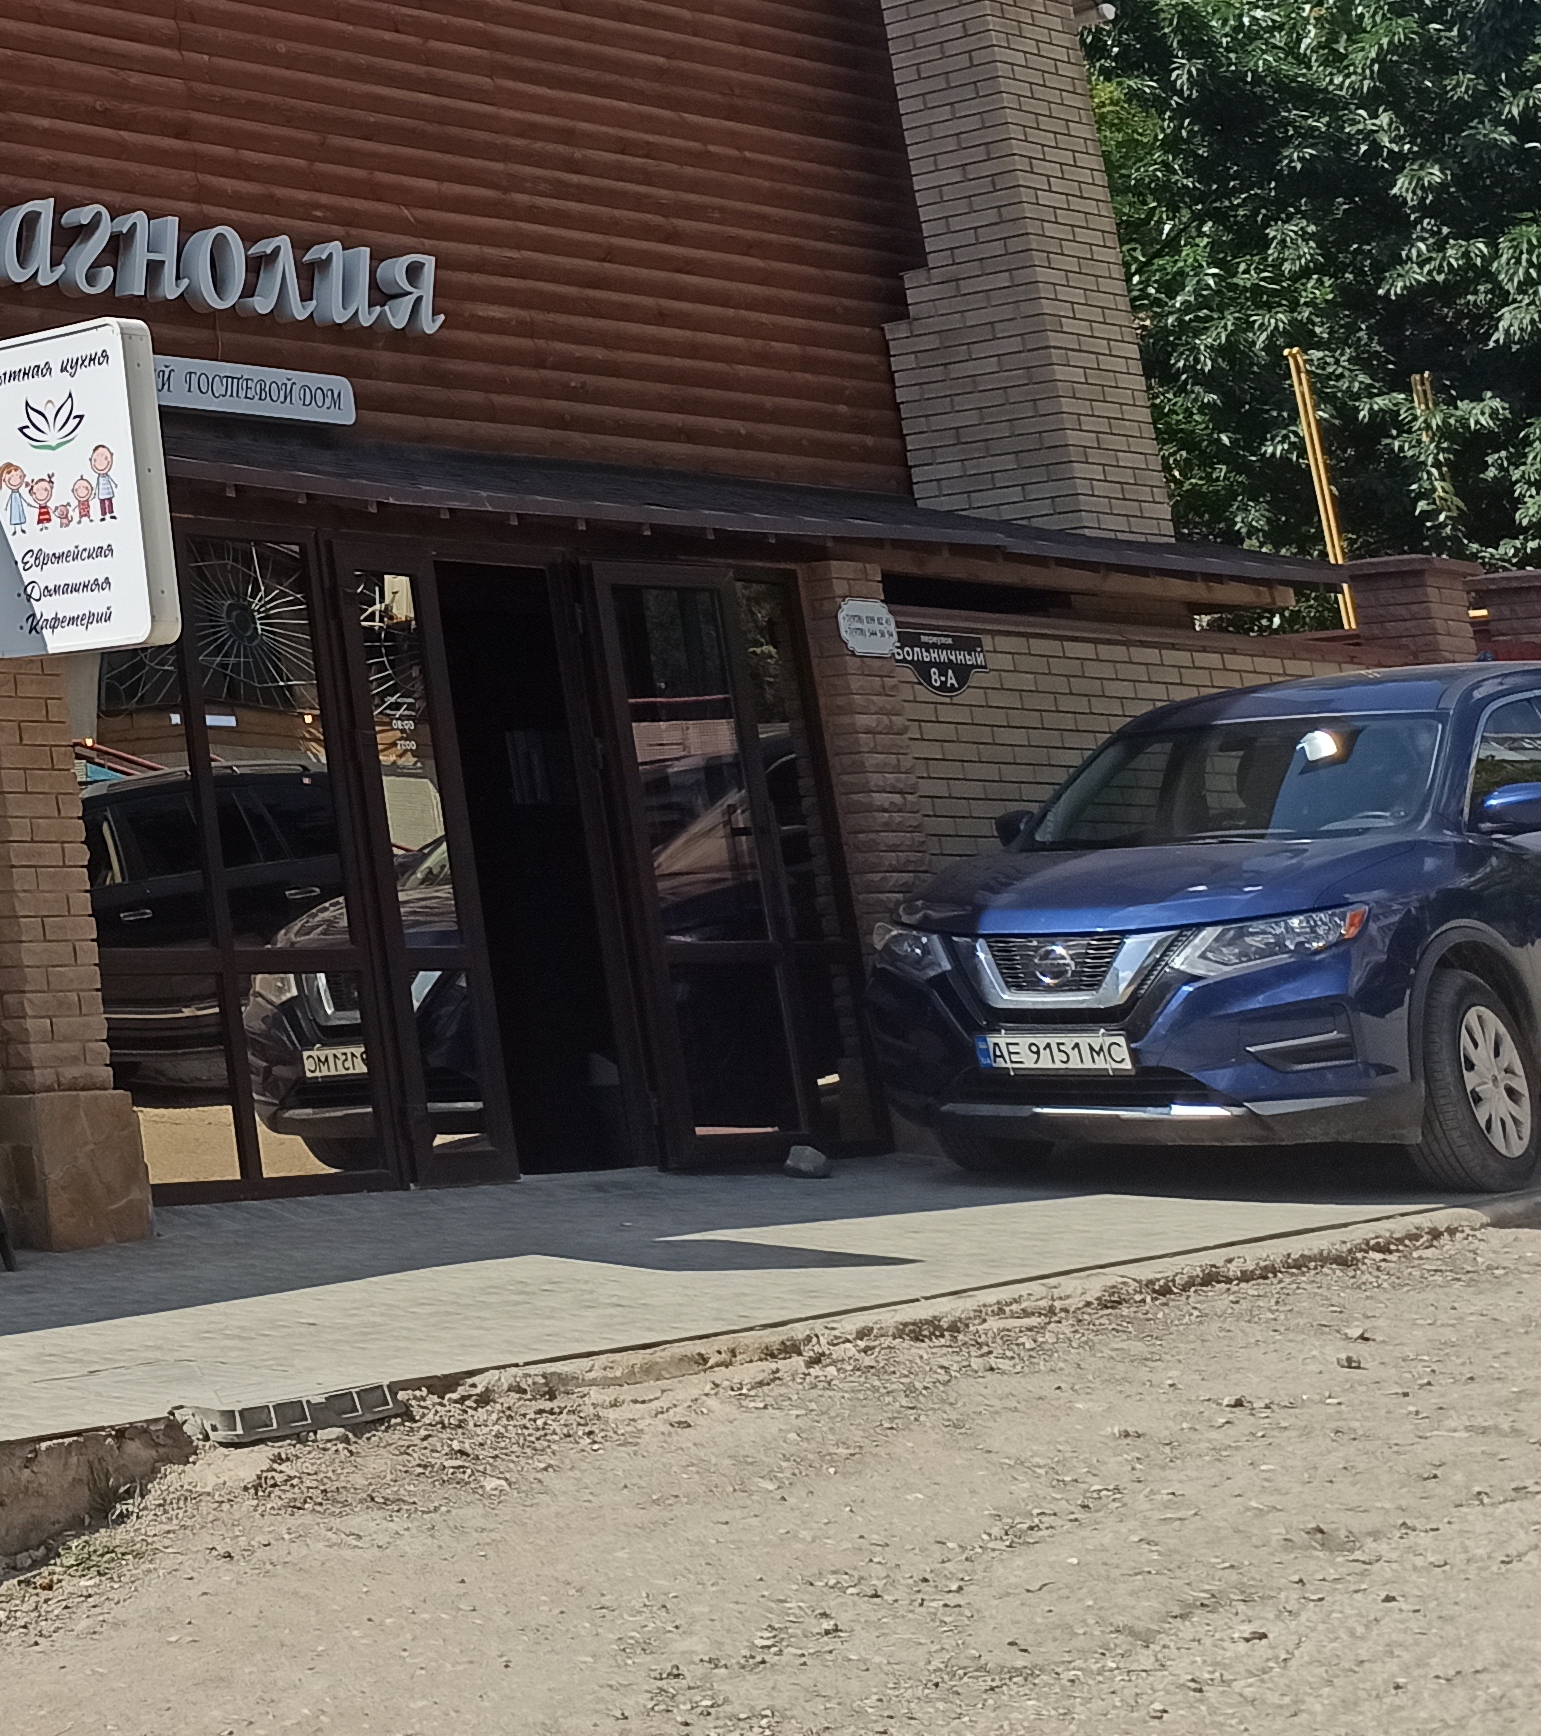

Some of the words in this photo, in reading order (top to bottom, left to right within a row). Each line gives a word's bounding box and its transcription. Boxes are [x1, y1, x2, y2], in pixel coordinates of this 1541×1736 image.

[59, 349, 110, 378] кухня
[184, 370, 297, 406] ГОСТЕВОЙ
[298, 384, 344, 411] ДОМ
[21, 544, 114, 572] Европейская
[23, 576, 112, 603] Домашняя
[25, 605, 113, 636] Кафетерий
[1027, 1042, 1084, 1065] 9151
